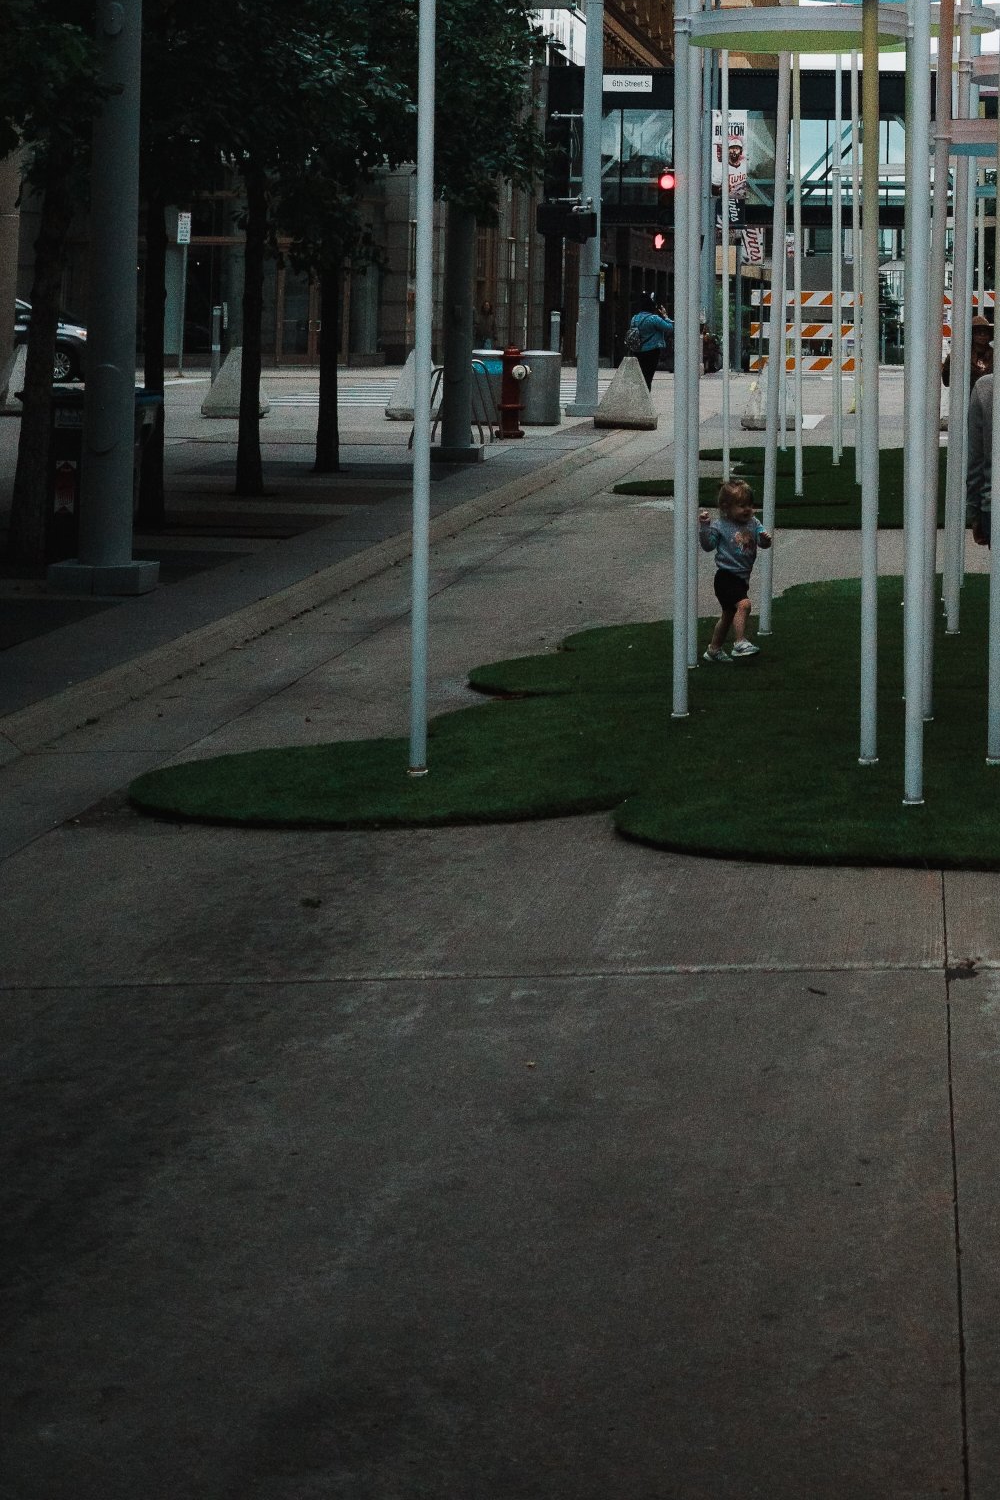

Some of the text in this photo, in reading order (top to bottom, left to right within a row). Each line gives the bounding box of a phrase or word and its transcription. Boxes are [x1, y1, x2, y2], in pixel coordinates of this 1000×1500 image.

[612, 79, 623, 87] 6th
[624, 79, 643, 87] Street
[714, 125, 745, 136] BTON
[727, 198, 741, 222] wins
